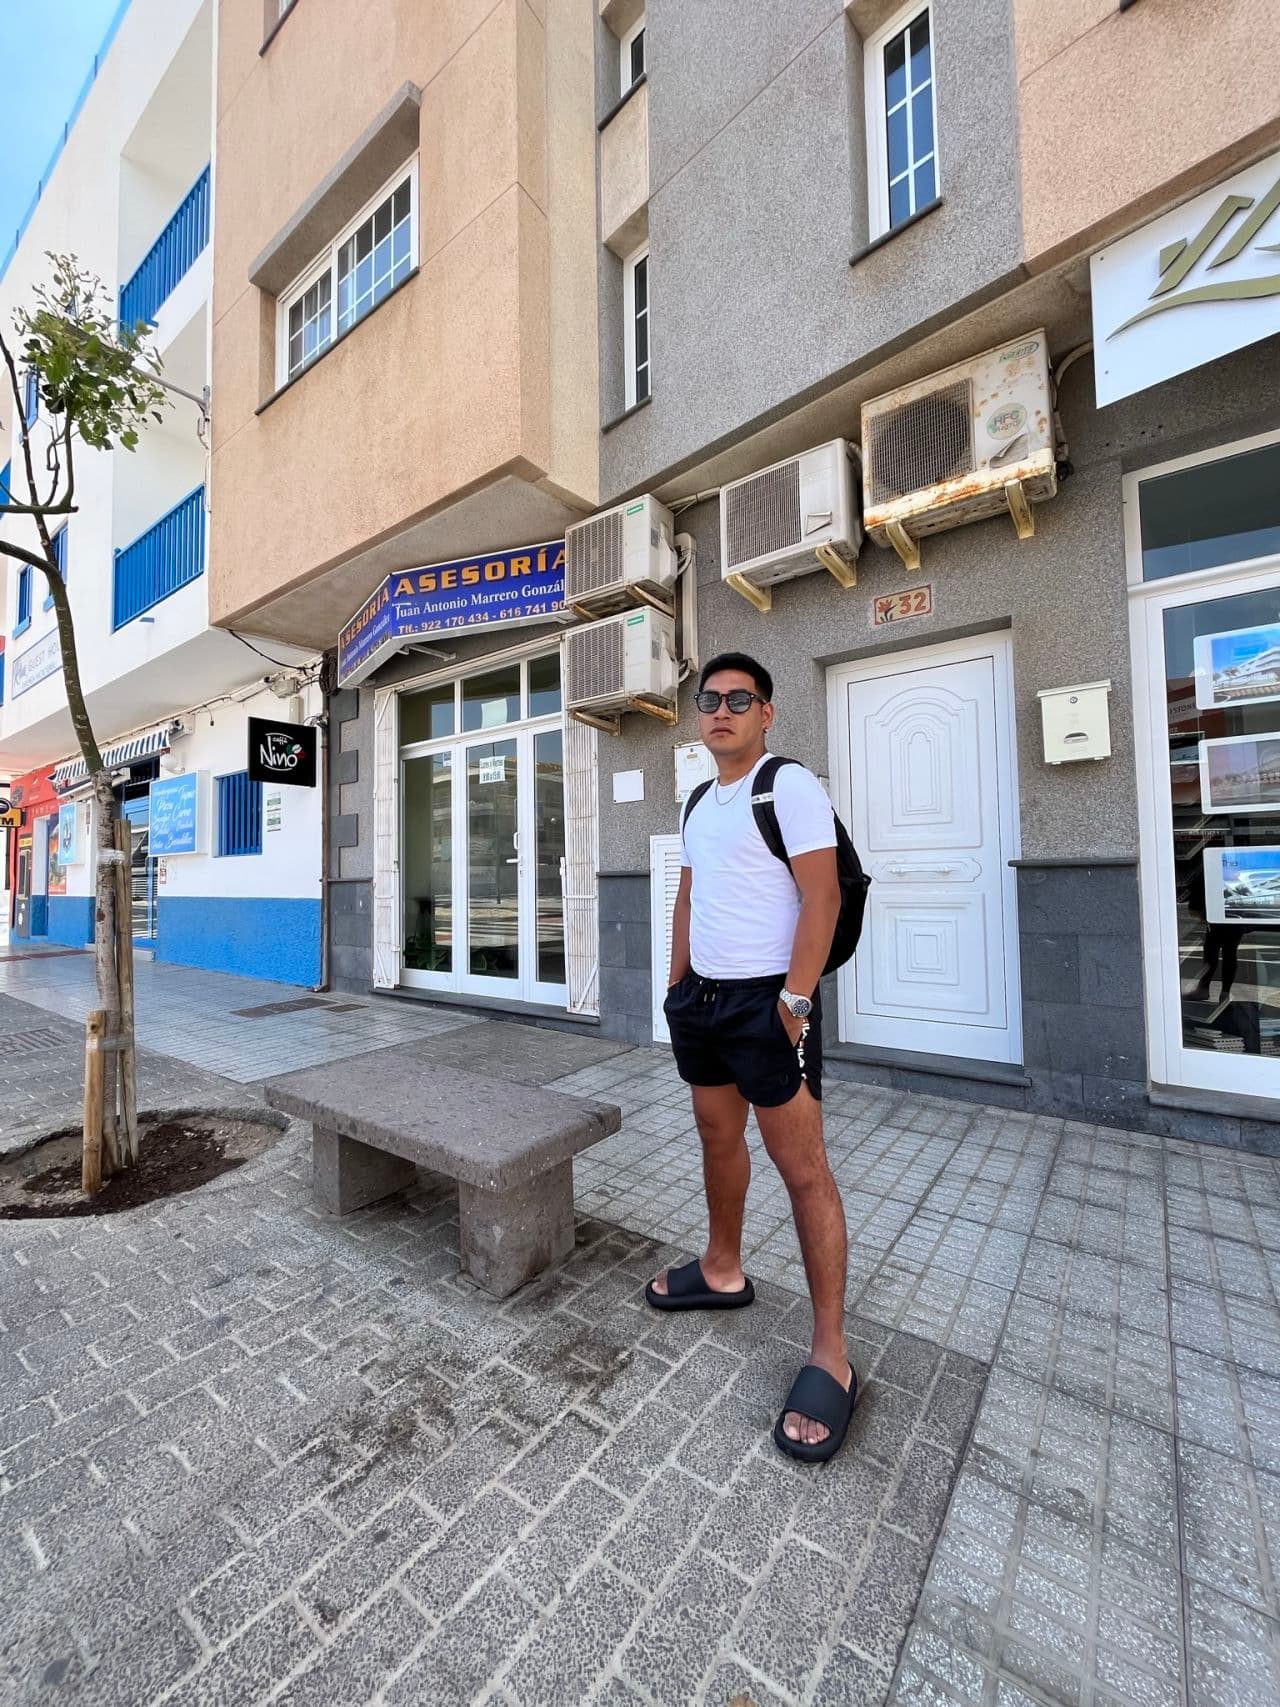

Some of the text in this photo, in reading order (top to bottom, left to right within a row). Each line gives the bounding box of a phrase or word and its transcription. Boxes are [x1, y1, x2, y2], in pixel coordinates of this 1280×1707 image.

[394, 547, 565, 597] ASESORÍA
[391, 579, 565, 620] Juan Antonio Marrero Gonzál
[421, 619, 441, 631] 922
[445, 615, 465, 627] 170
[468, 612, 489, 623] 434
[500, 607, 521, 619] 616
[525, 603, 546, 615] 741
[551, 600, 565, 612] 90
[898, 591, 927, 615] 32
[260, 735, 298, 768] Nino
